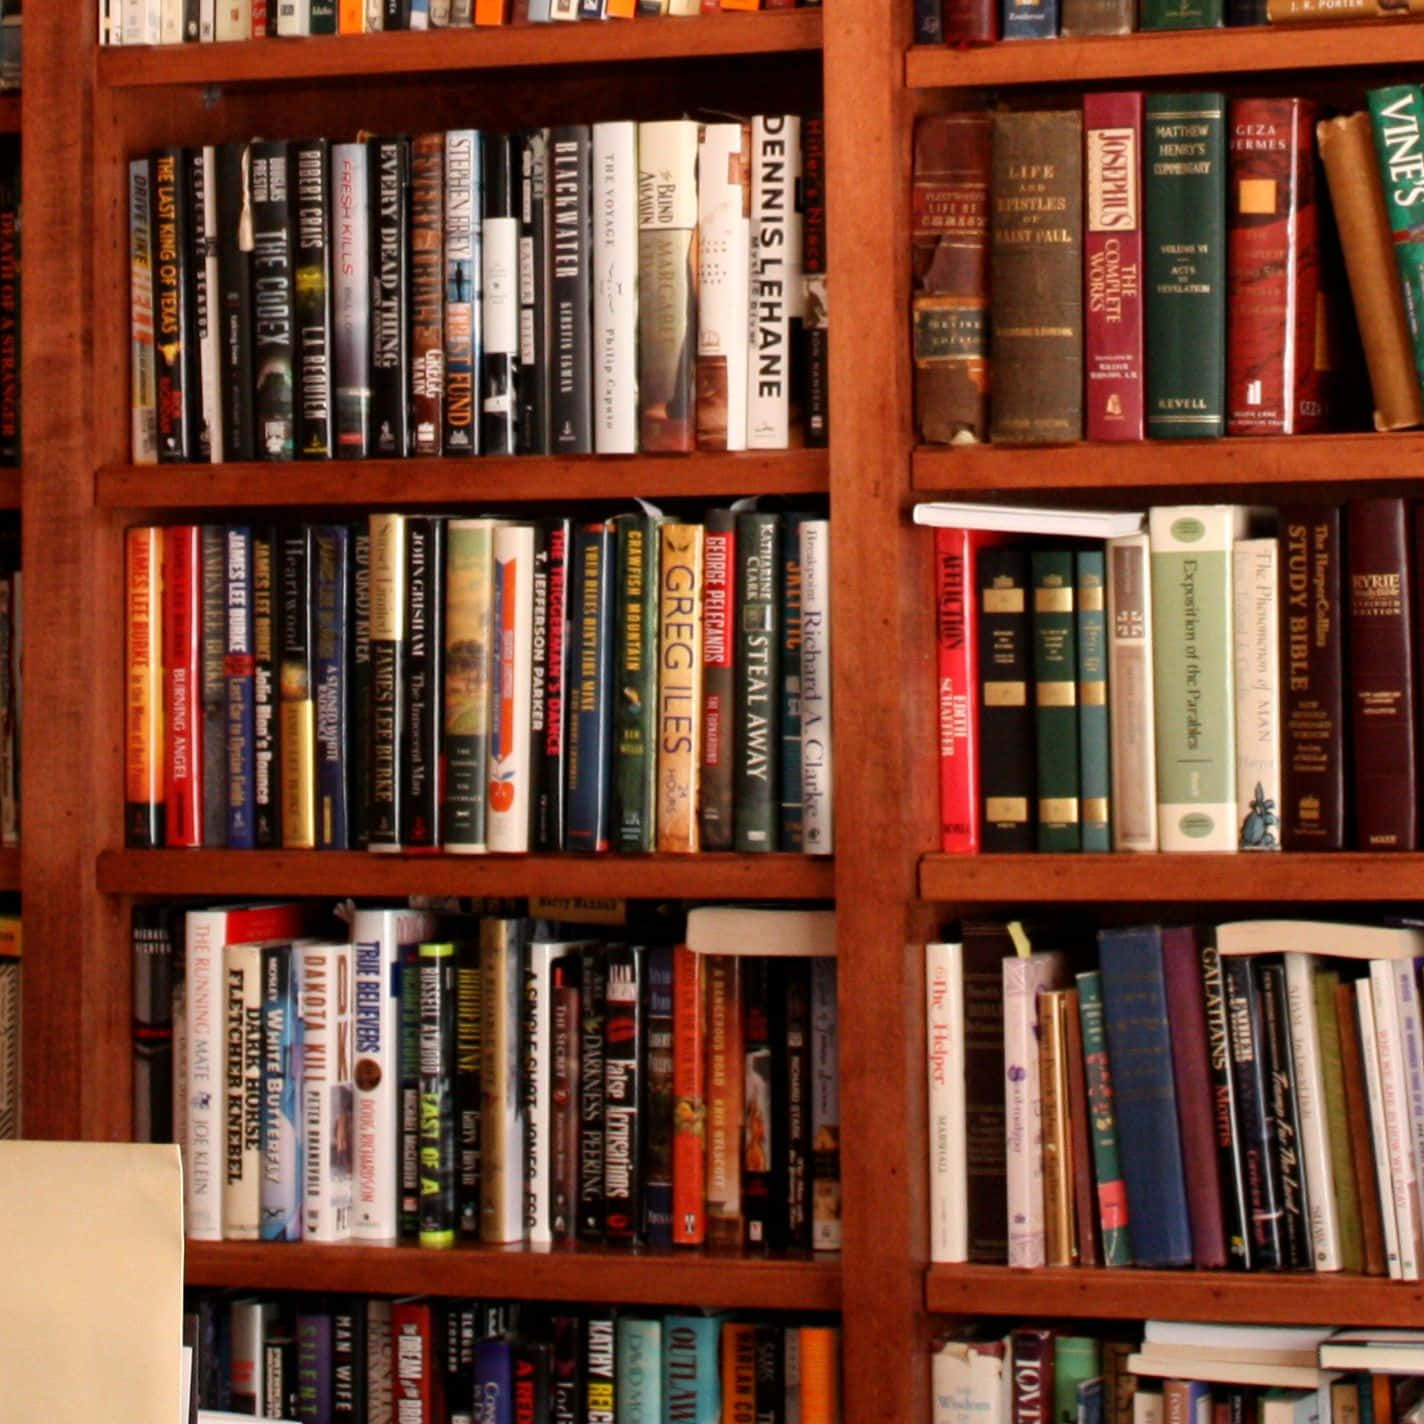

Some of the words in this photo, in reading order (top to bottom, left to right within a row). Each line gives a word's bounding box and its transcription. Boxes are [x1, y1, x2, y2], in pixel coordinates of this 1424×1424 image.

[380, 145, 397, 222] EVERY
[555, 142, 579, 278] BLACKWATER
[761, 117, 784, 251] DENNIS
[1099, 132, 1131, 227] JOSEPHUS
[255, 229, 287, 268] THE
[380, 228, 398, 289] DEAD
[1090, 255, 1104, 312] WORKS
[1104, 240, 1121, 324] COMPLETE
[1121, 264, 1137, 296] THE
[256, 278, 289, 345] CODEX
[381, 296, 400, 368] THING
[759, 258, 783, 397] LEHANE
[412, 532, 424, 577] JOHN
[412, 581, 424, 656] GRISHAM
[534, 573, 547, 661] JEFFERSON
[665, 566, 694, 669] GREG
[1183, 560, 1201, 639] Exposition
[747, 635, 768, 705] STEAL
[1184, 644, 1200, 658] of
[1186, 662, 1200, 686] the
[532, 668, 544, 730] PARKER
[663, 687, 692, 753] ILES
[1186, 691, 1203, 750] Parables
[747, 714, 768, 781] AWAY
[357, 942, 380, 981] TRUE
[228, 969, 244, 1088] FLETCHER
[247, 1007, 261, 1070] DARK
[356, 982, 380, 1052] BELIEVERS
[228, 1095, 243, 1185] KNEBEL
[245, 1077, 261, 1150] HORSE
